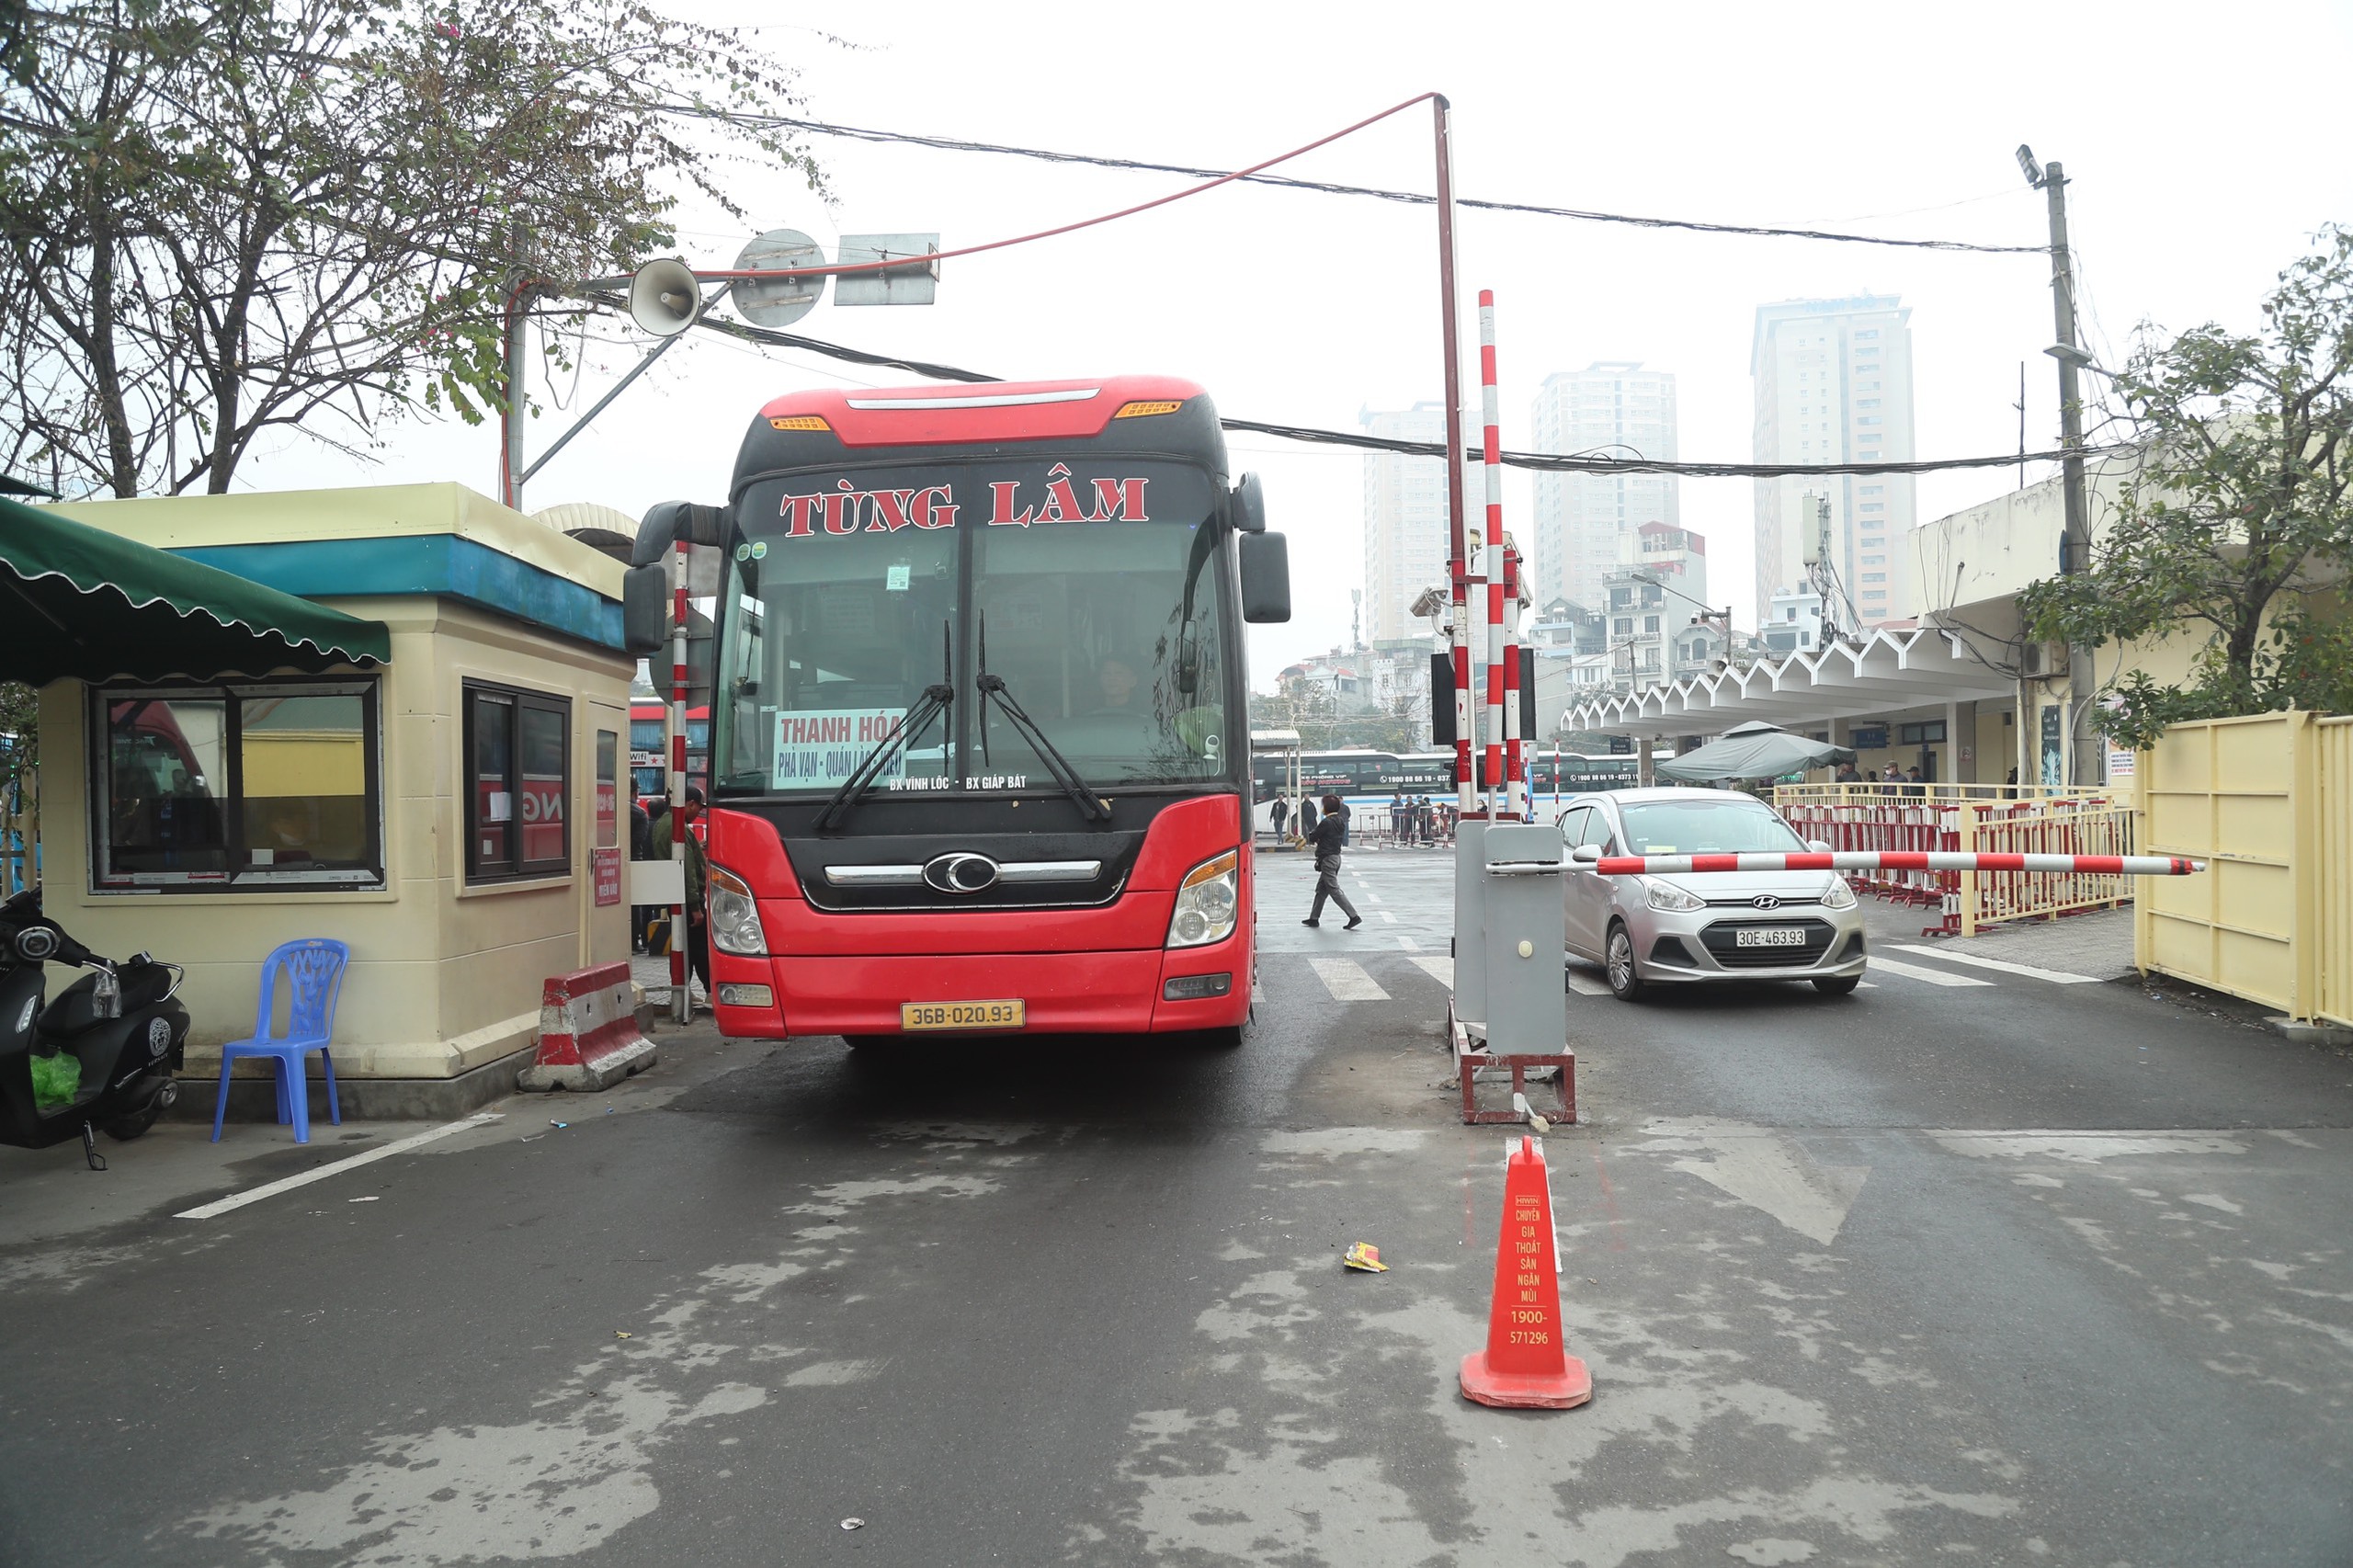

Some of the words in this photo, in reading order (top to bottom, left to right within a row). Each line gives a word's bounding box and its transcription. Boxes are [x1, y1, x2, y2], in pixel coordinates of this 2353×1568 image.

[779, 479, 961, 538] TÙNG
[988, 462, 1149, 528] LÂM
[781, 717, 851, 744] THANH
[858, 710, 903, 742] HÓA
[826, 746, 851, 779] QUÁN
[890, 778, 904, 790] BX
[905, 776, 928, 790] VĨNH
[966, 777, 980, 790] BX
[982, 774, 1006, 790] GIÁP
[1007, 773, 1027, 789] BÁT
[1739, 930, 1803, 945] 30E-463.93
[913, 1006, 1013, 1025] 36B-020.93
[1517, 1197, 1539, 1205] HIWIN
[1516, 1207, 1540, 1221] CHUYÊN
[1521, 1226, 1536, 1238] GIA
[1515, 1240, 1541, 1255] THOÁT
[1520, 1256, 1537, 1270] SÀN
[1518, 1273, 1540, 1287] NGĂN
[1520, 1288, 1537, 1302] MÙI
[1511, 1311, 1548, 1324] 1900-
[1510, 1332, 1549, 1345] 571296
